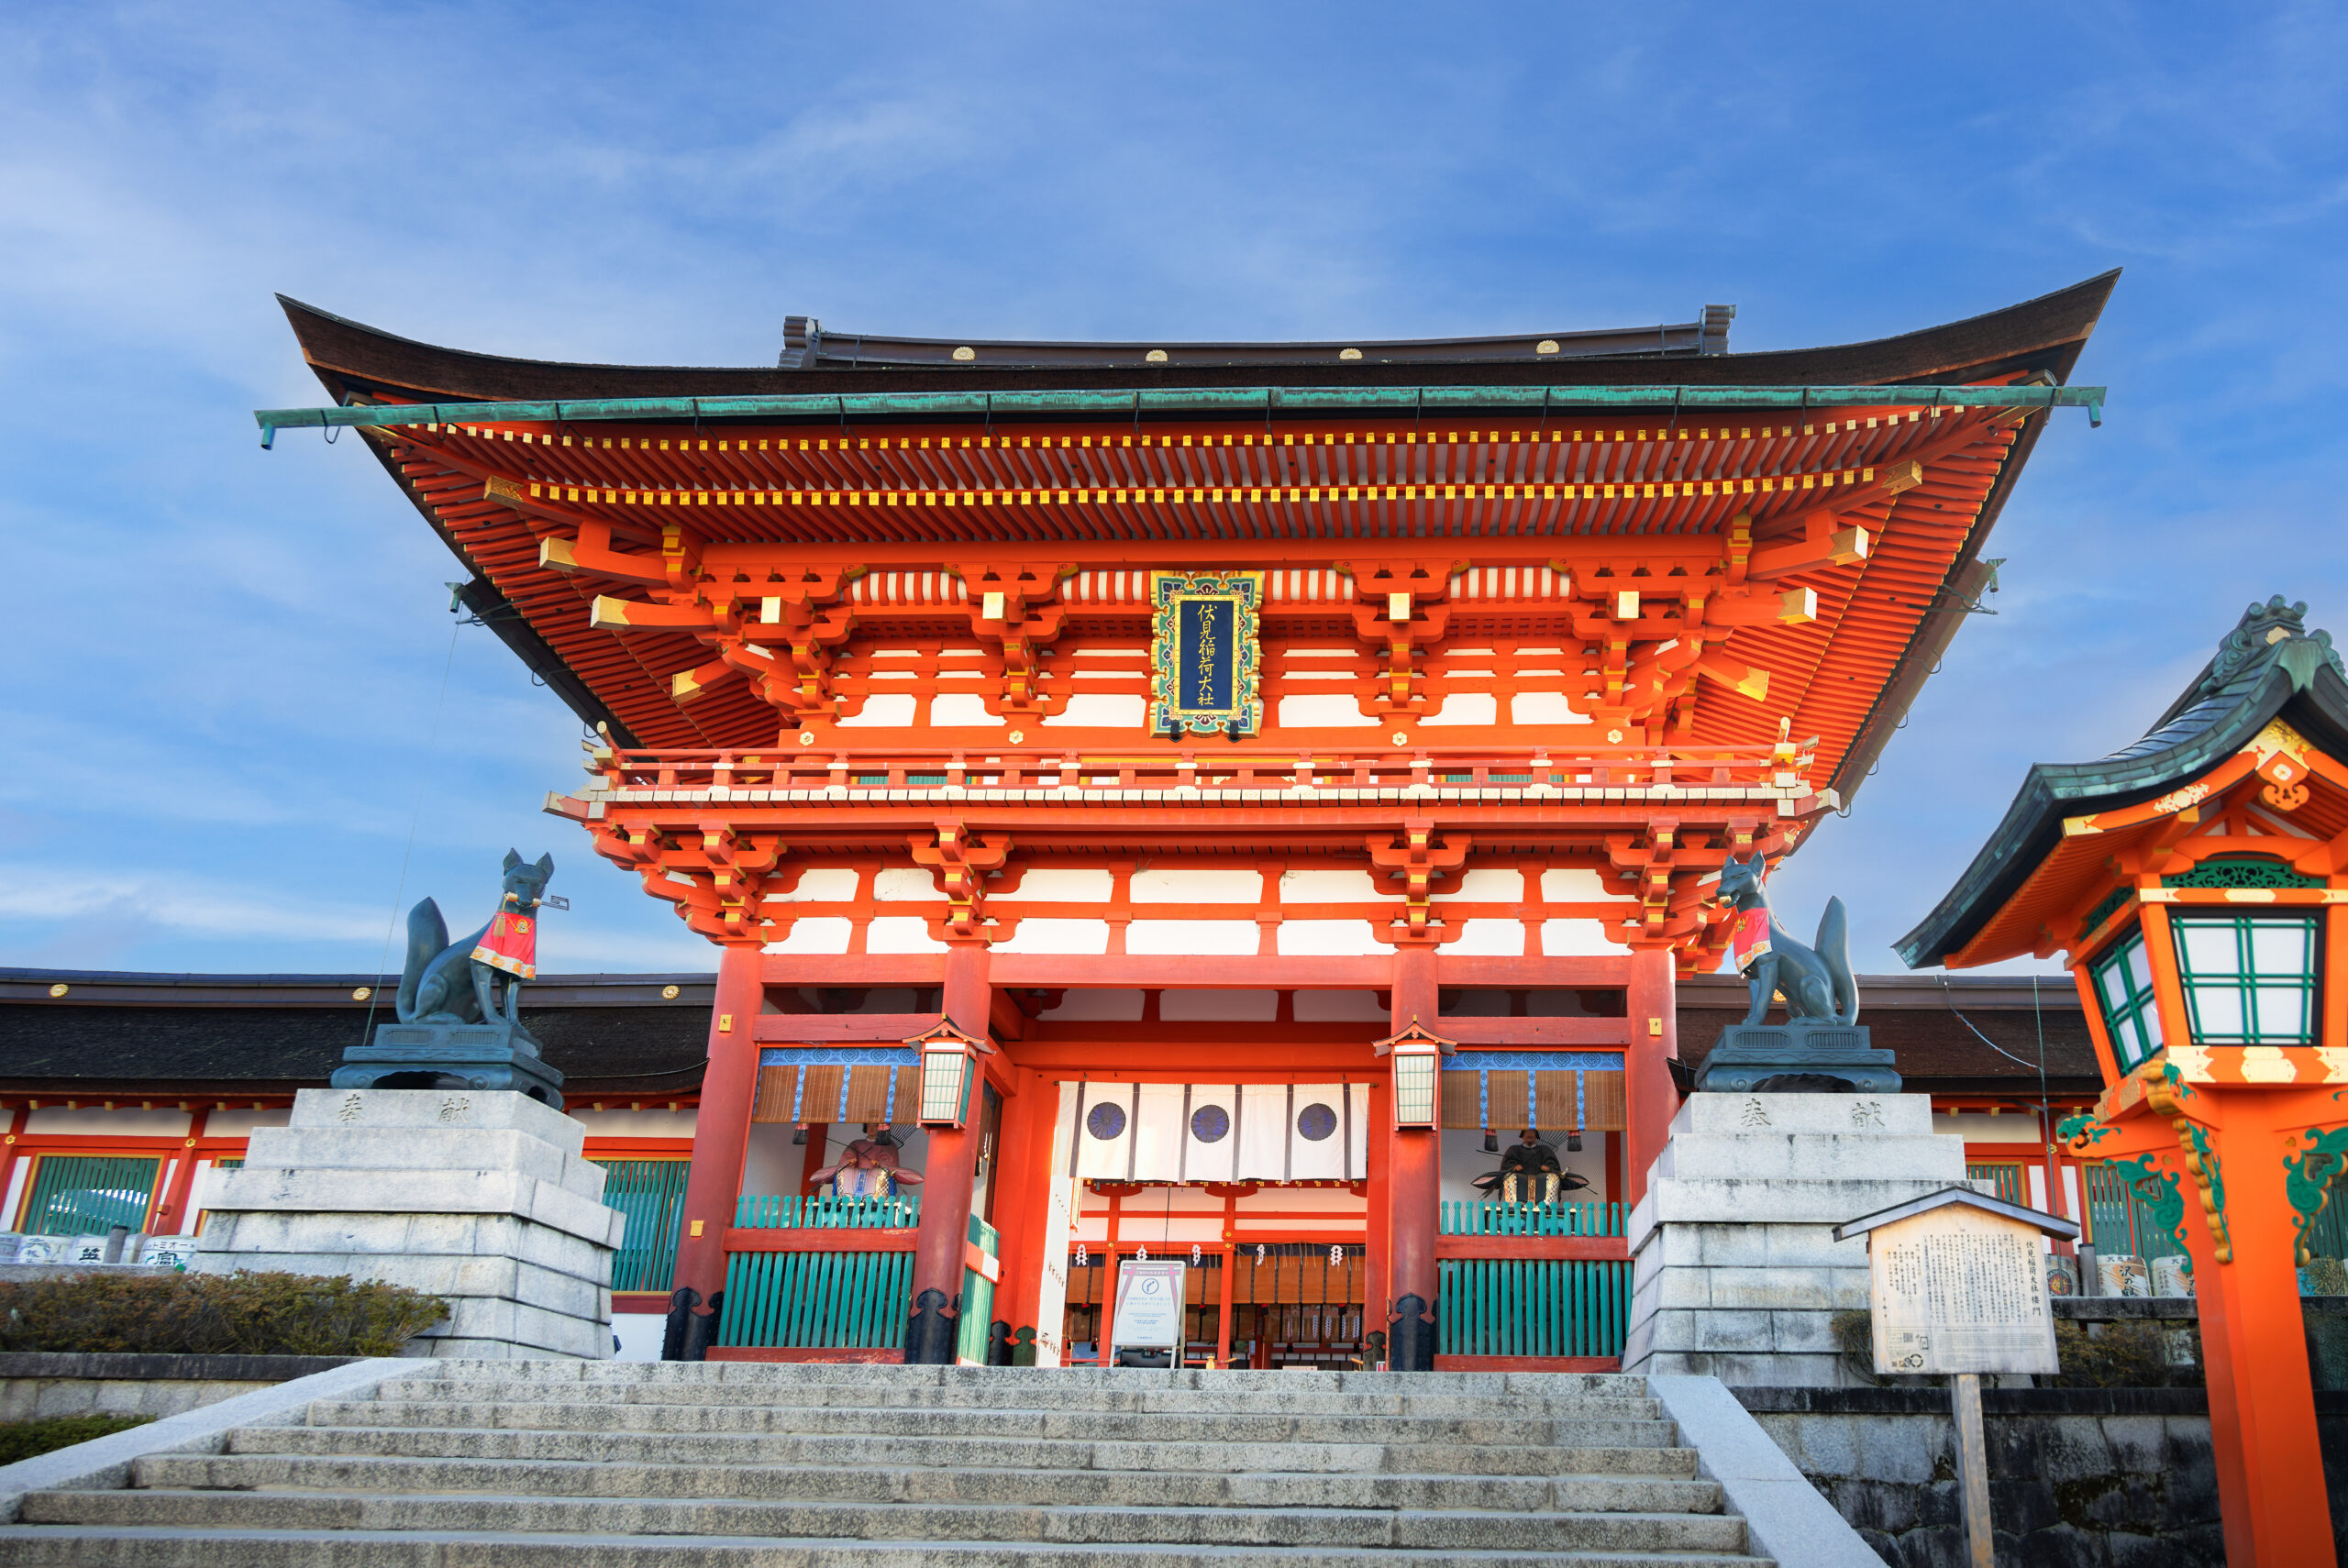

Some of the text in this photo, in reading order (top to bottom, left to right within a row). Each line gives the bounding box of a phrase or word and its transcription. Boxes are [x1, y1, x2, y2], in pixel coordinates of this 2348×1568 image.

[1197, 603, 1218, 706] 伏見稲荷大社
